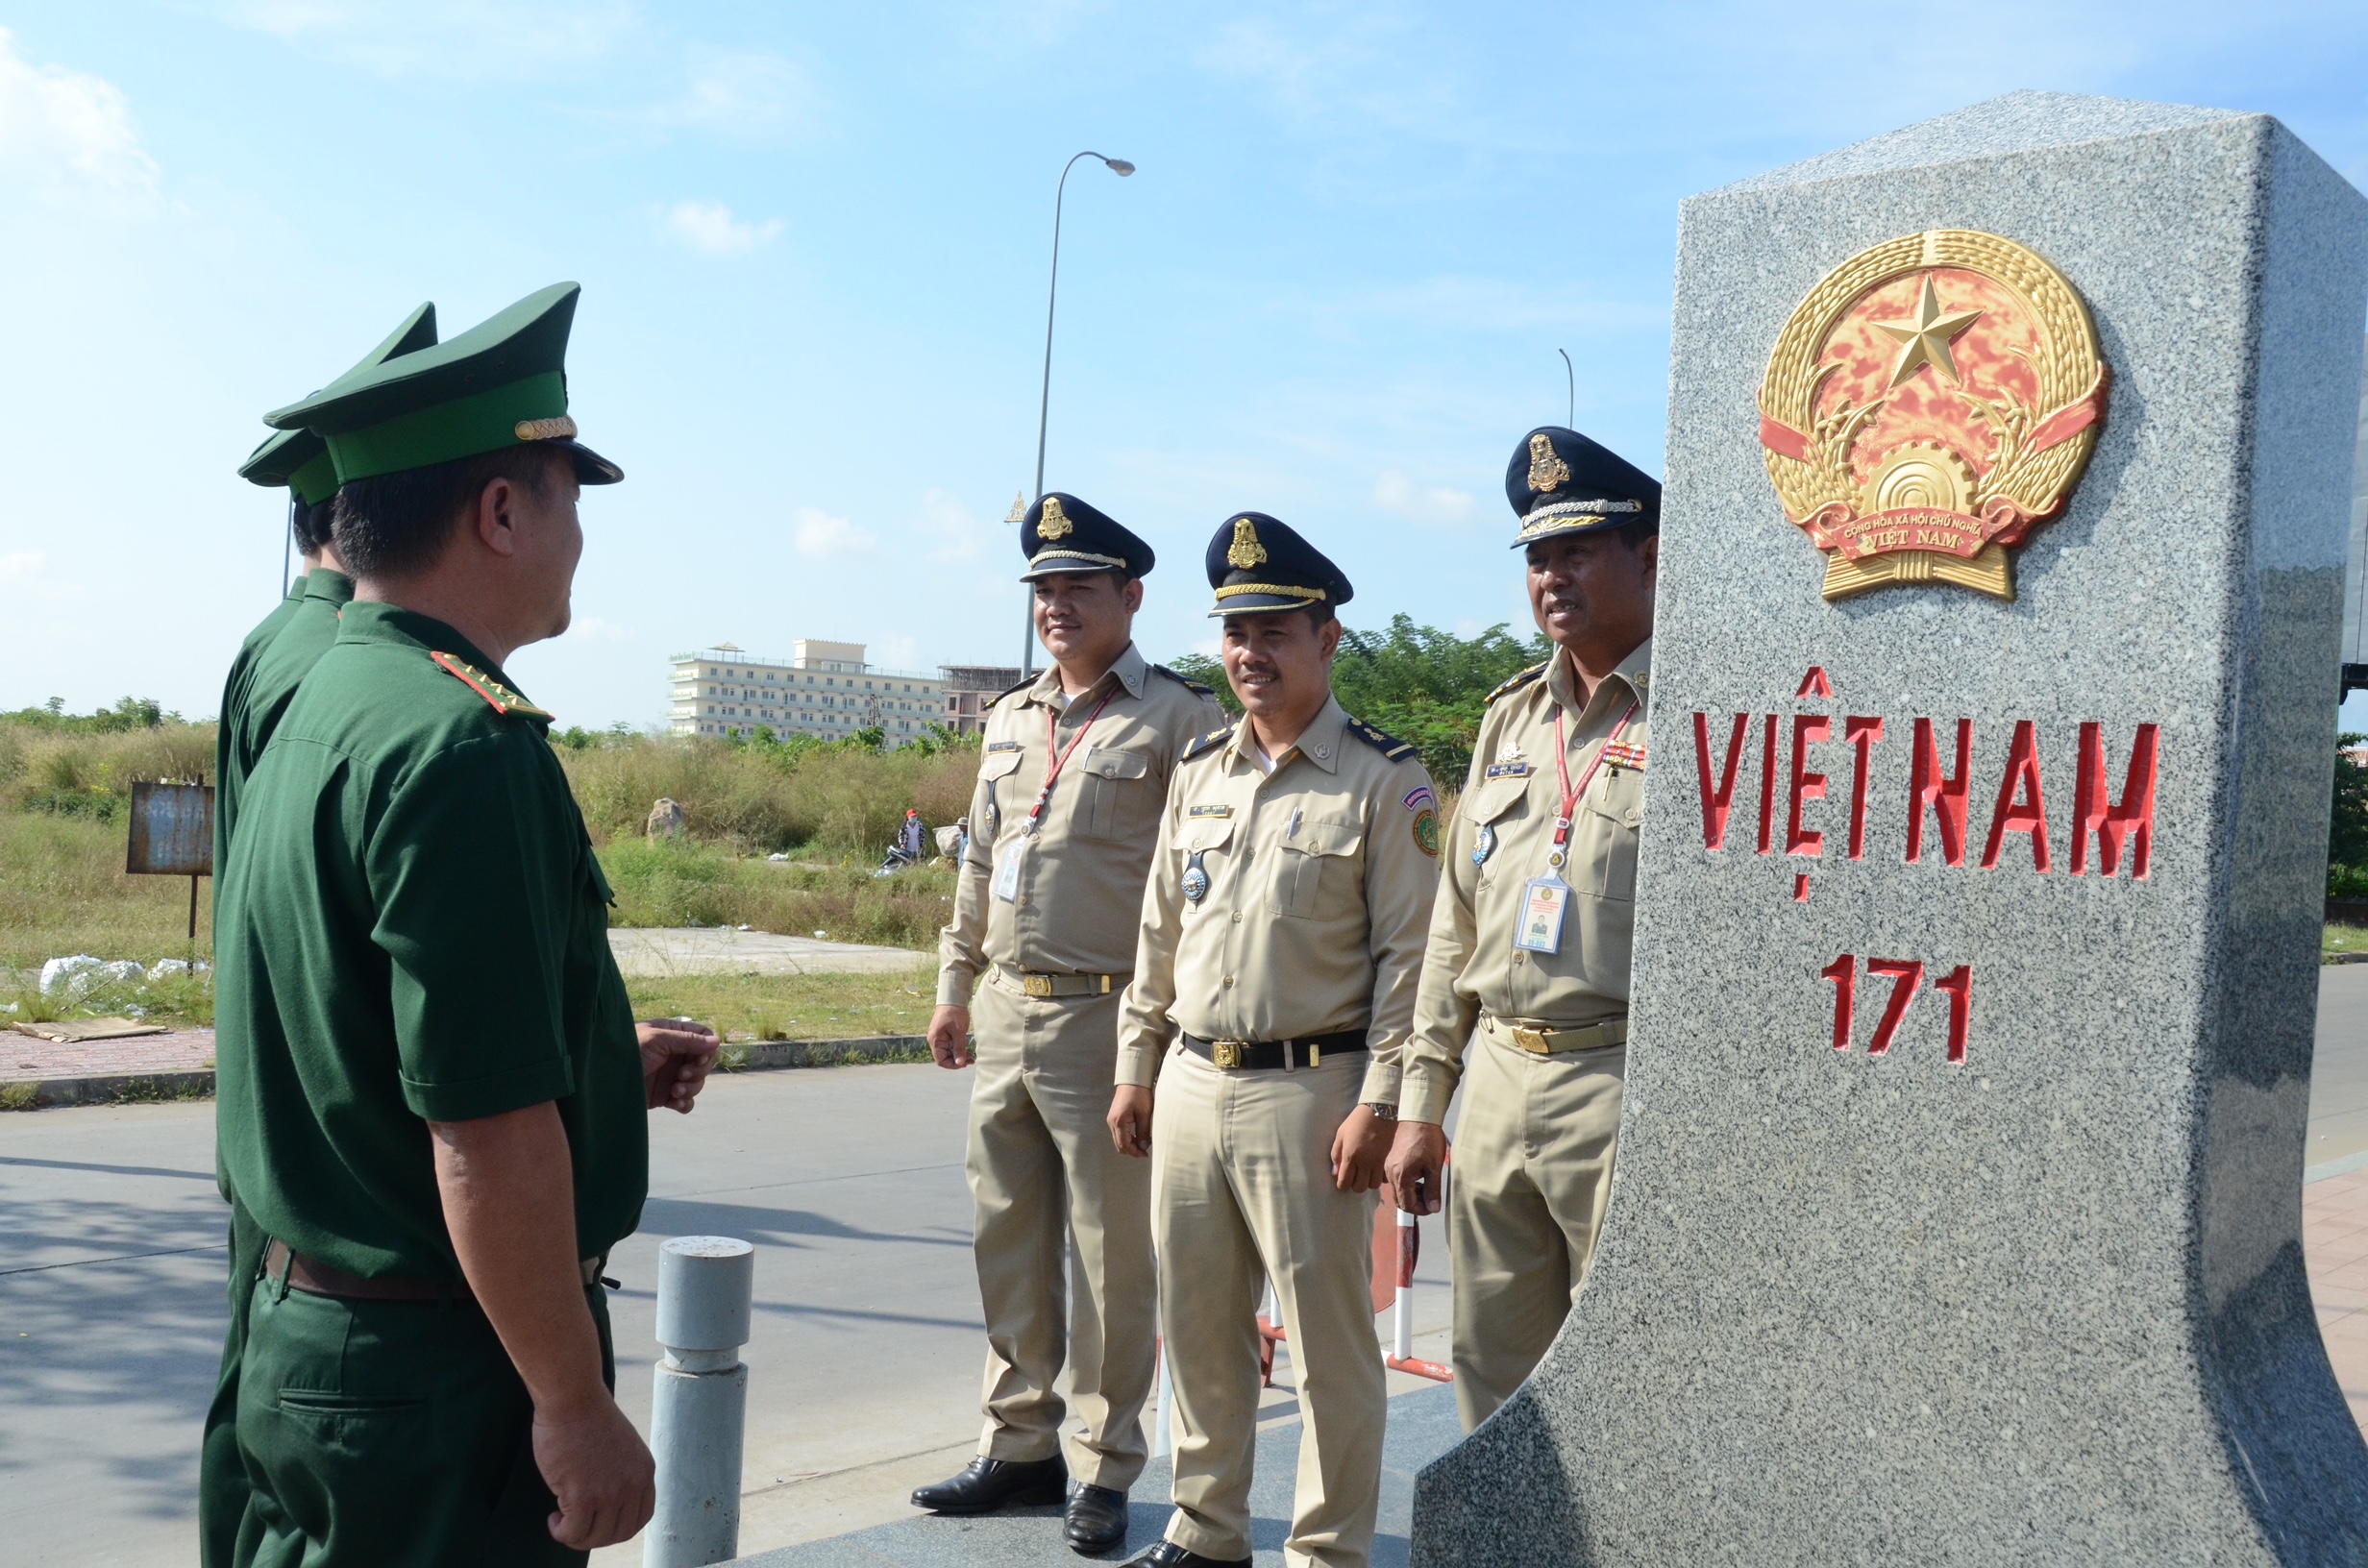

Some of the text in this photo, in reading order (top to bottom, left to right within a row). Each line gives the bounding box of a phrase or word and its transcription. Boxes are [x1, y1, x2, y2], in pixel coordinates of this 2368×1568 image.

[1844, 513, 1984, 539] CỘNG HÒA XÃ HỘI CHỦ NGHĨA
[1866, 527, 1961, 551] VIỆT NAM
[1692, 666, 1884, 902] VIỆT
[1905, 717, 2159, 881] NAM
[1821, 953, 1973, 1066] 171
